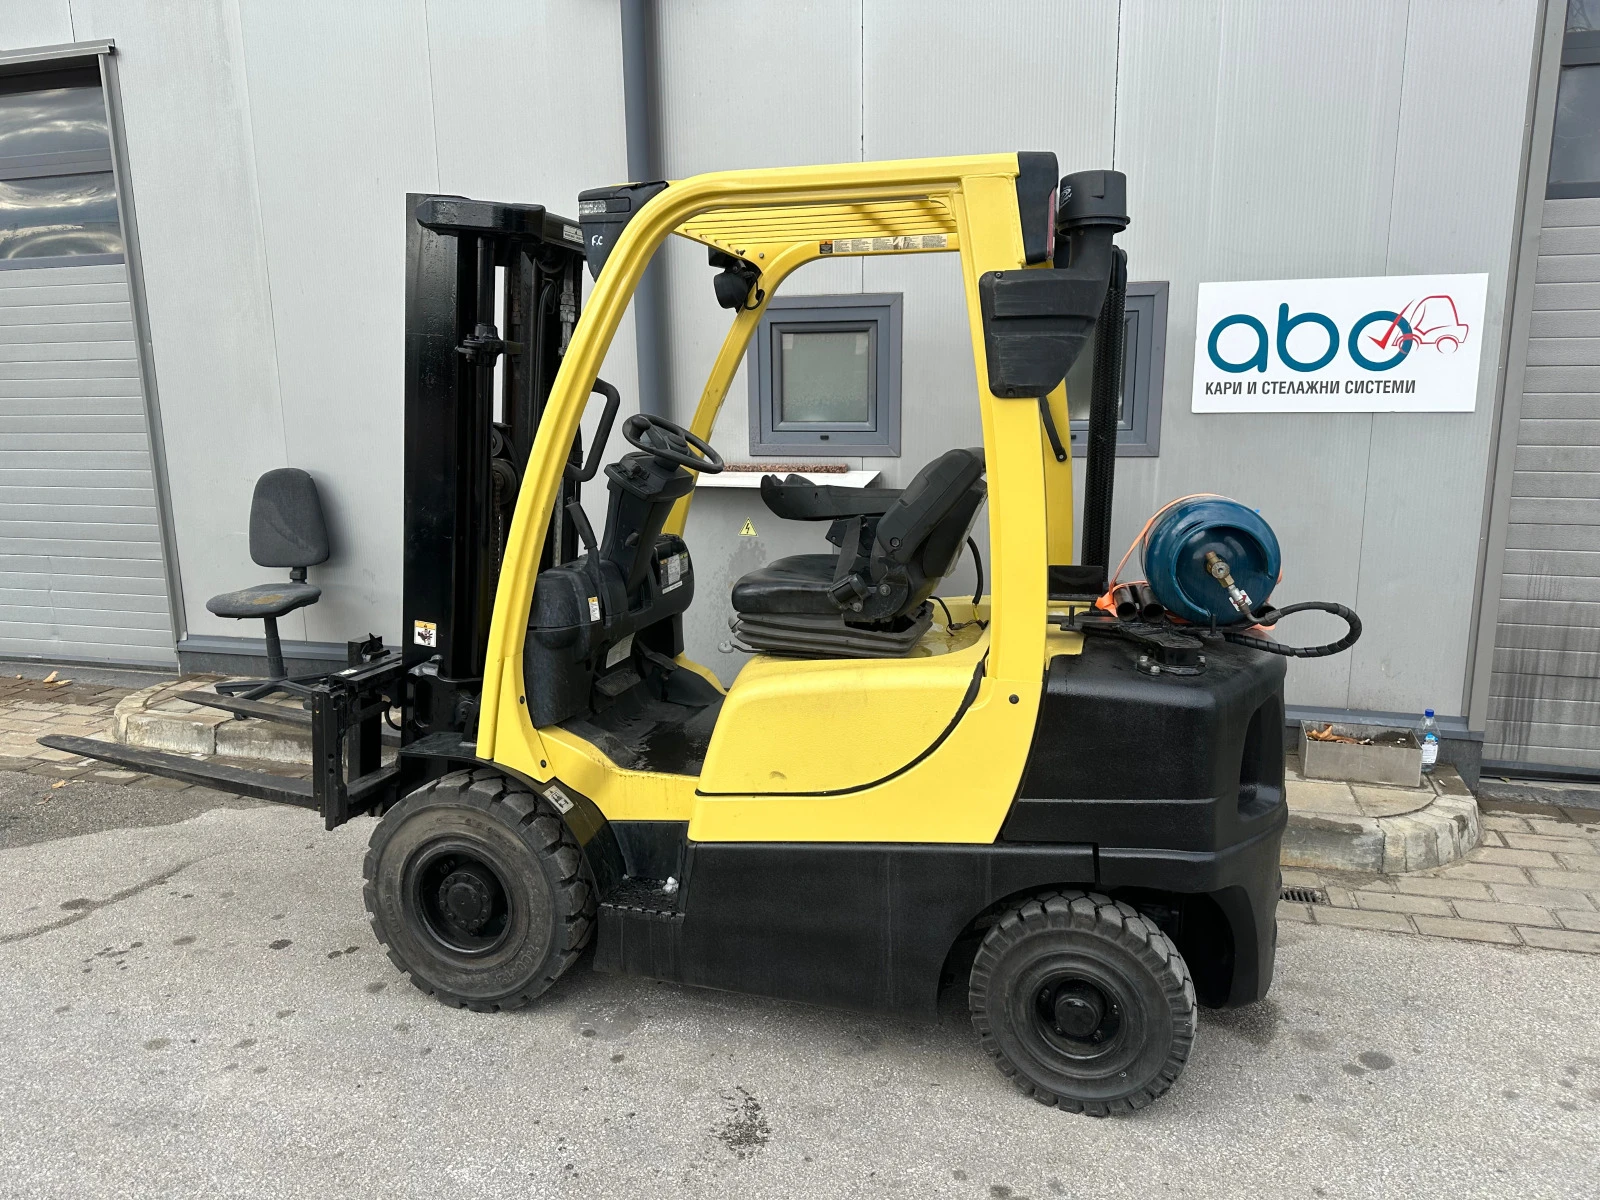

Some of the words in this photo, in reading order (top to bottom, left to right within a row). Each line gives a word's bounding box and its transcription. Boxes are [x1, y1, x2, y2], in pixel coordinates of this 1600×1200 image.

[1208, 302, 1413, 373] abo
[1205, 381, 1242, 395] КАРИ
[1247, 381, 1256, 395] И
[1261, 380, 1340, 395] СТЕЛАЖНИ
[1344, 379, 1416, 394] СИСТЕМИ
